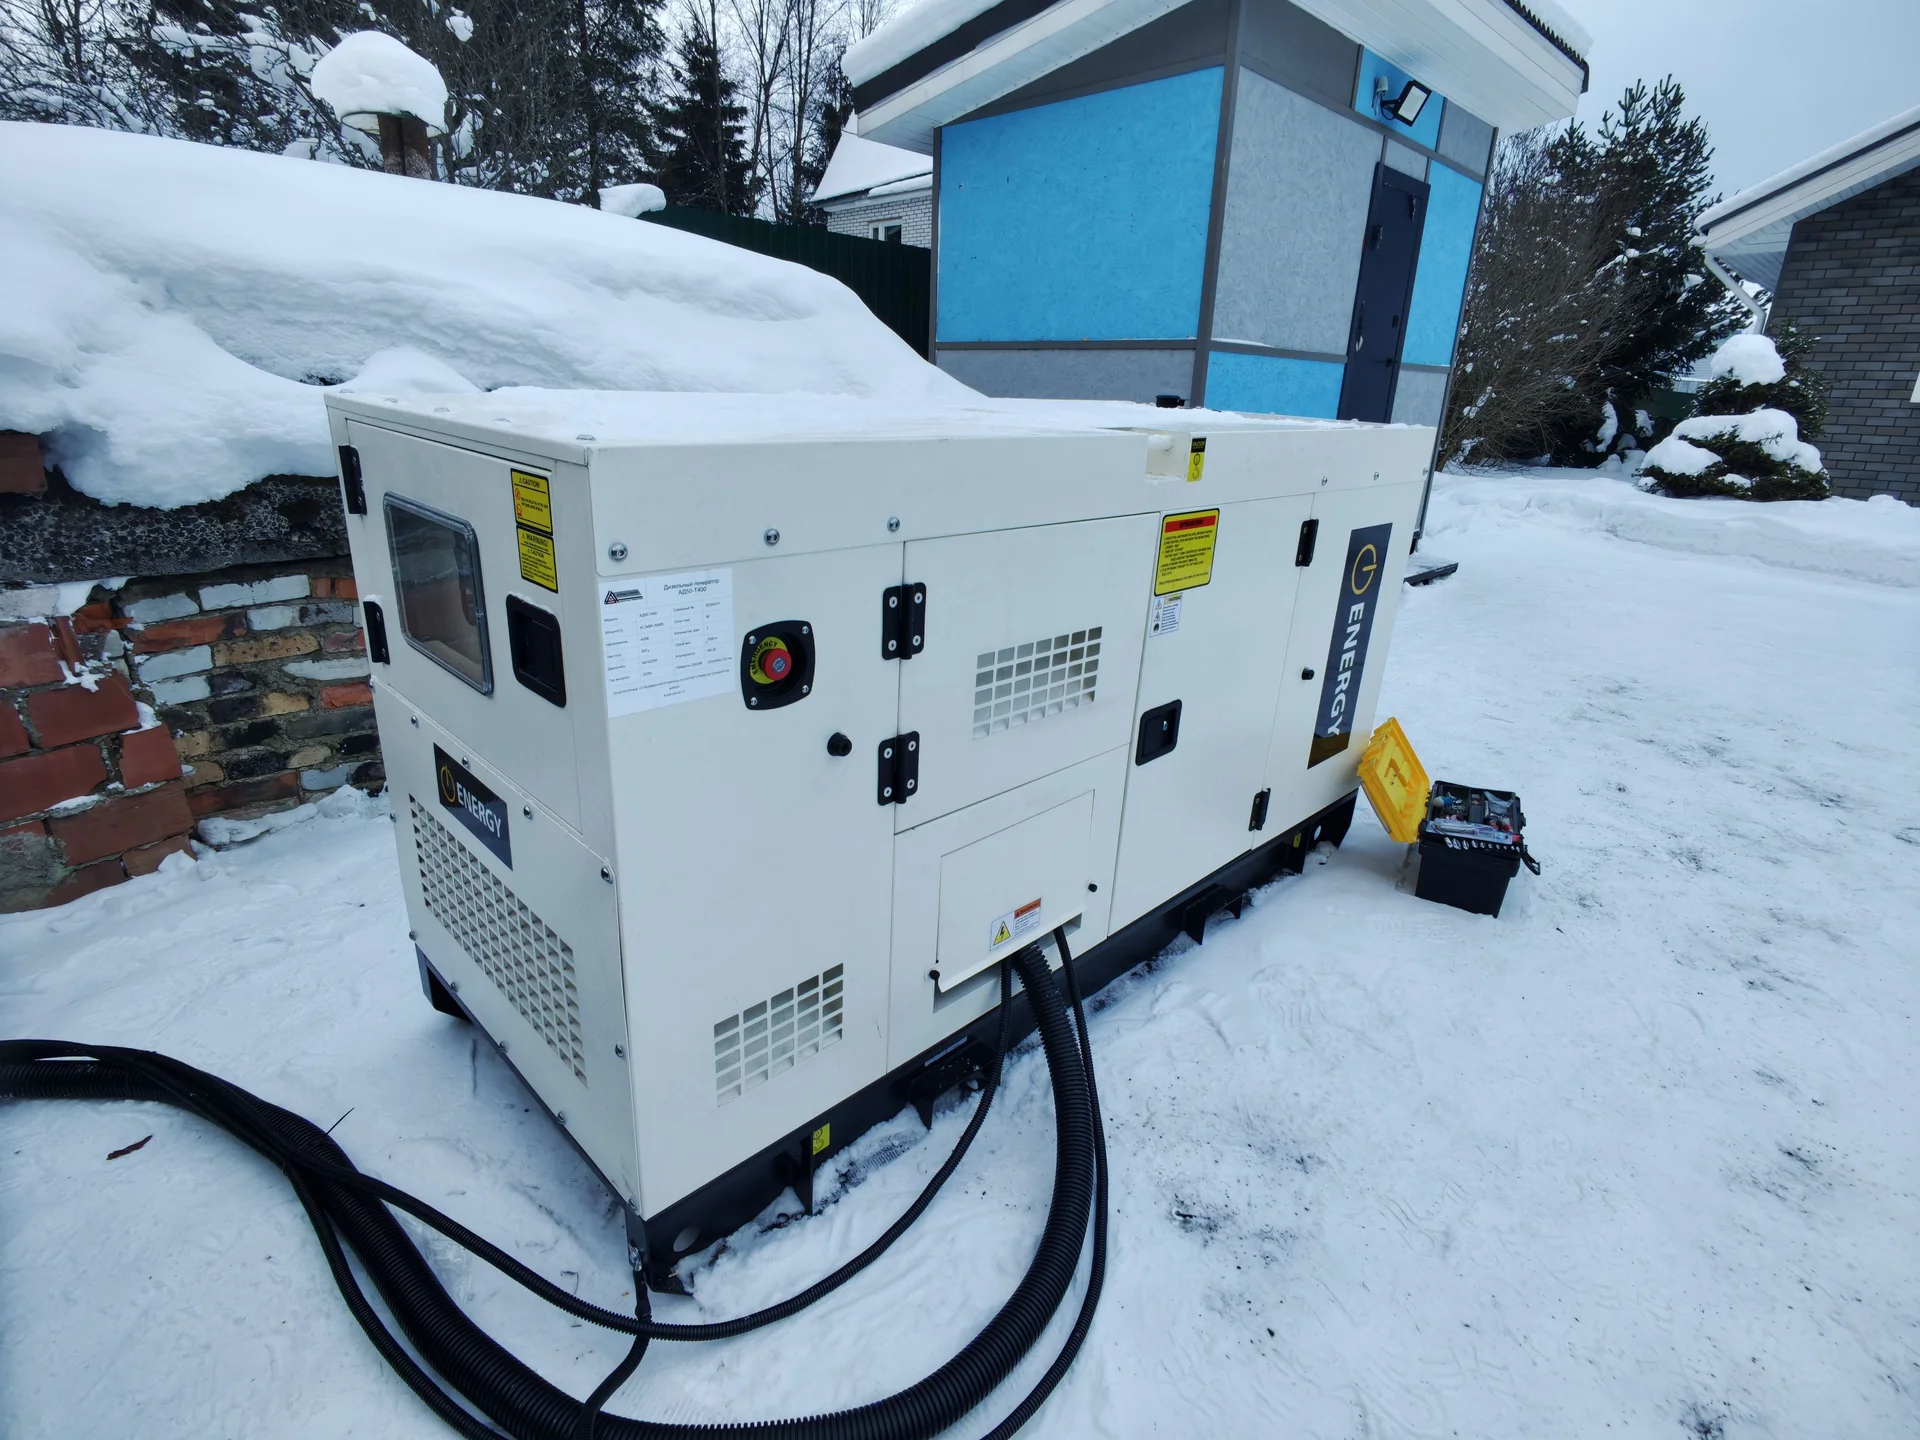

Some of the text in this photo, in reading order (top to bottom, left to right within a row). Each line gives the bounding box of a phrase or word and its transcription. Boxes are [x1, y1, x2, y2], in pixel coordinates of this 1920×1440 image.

[663, 579, 720, 591] Дизельный генератор
[751, 641, 778, 675] EMERGENCY
[1327, 601, 1366, 736] ENERGY
[456, 781, 502, 838] ENERGY
